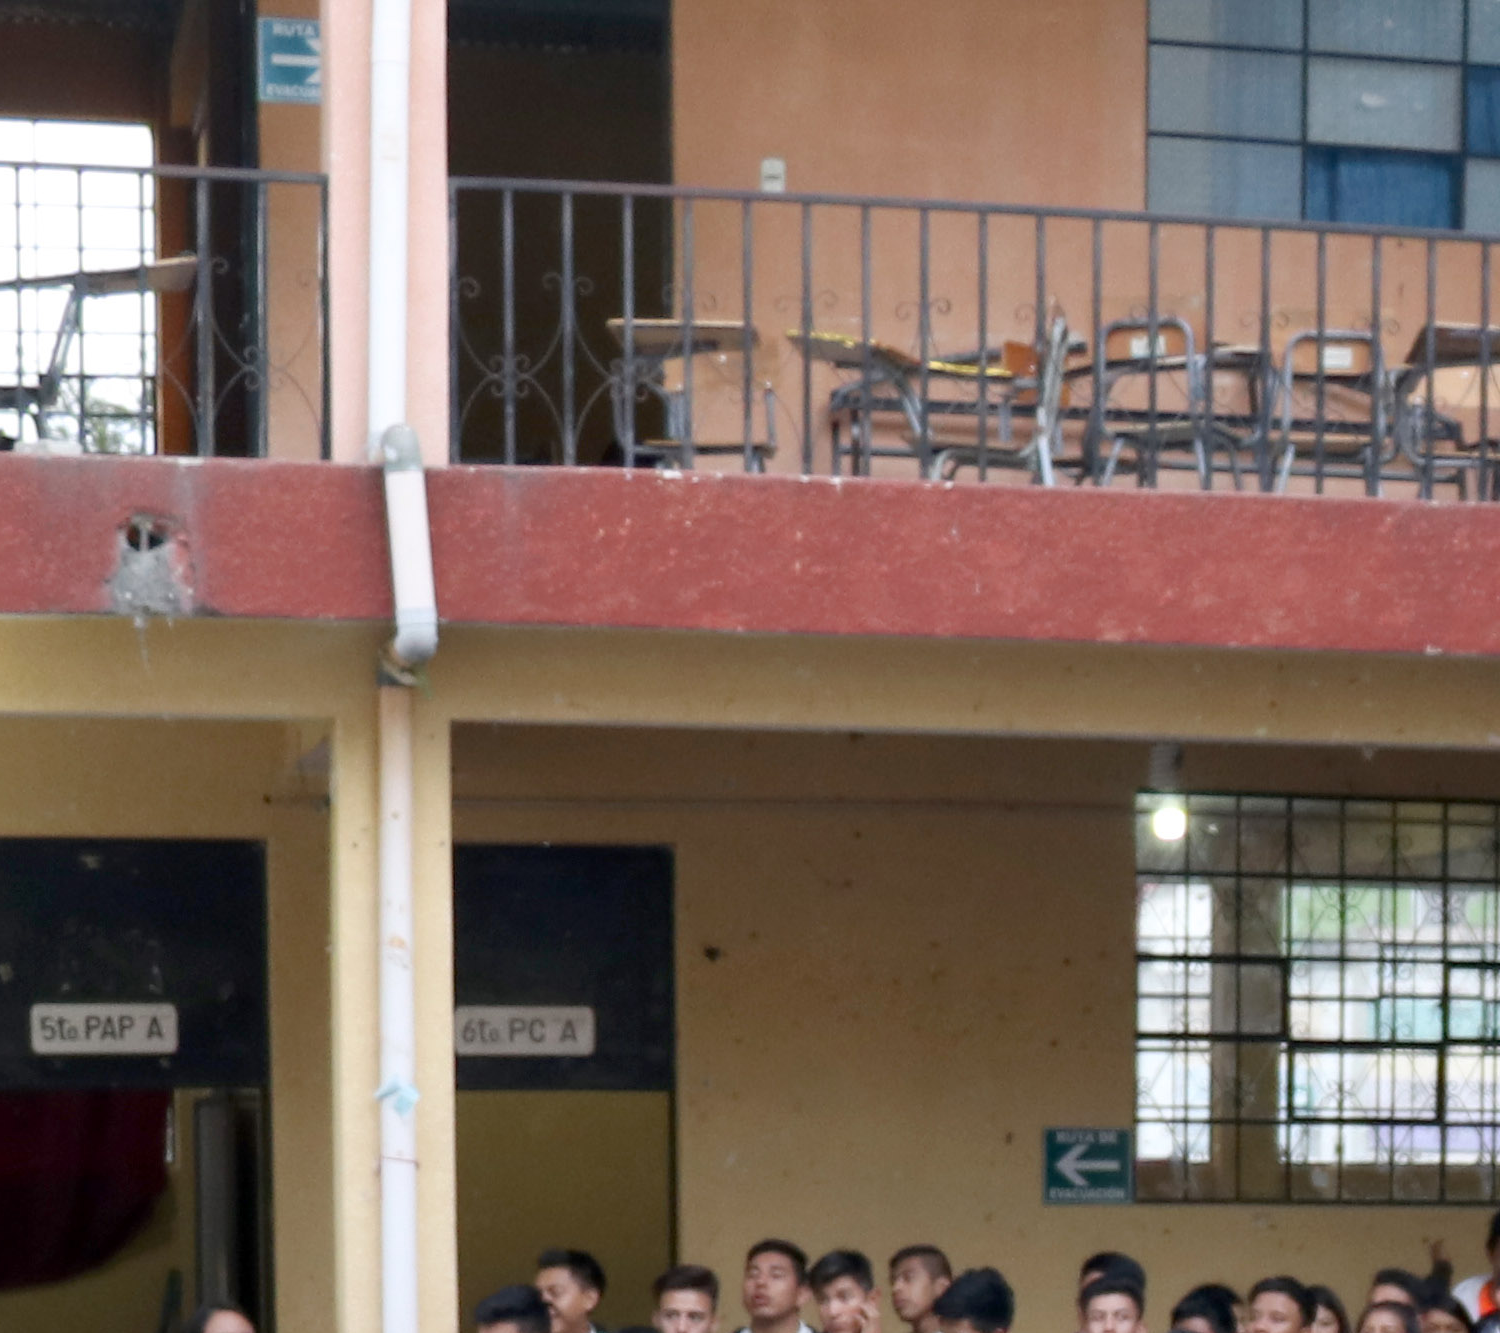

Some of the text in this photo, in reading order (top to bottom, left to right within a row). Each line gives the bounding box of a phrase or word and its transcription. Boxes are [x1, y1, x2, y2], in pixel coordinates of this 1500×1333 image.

[273, 23, 317, 37] RUTA
[84, 1015, 135, 1041] PAP
[507, 1017, 546, 1043] PC
